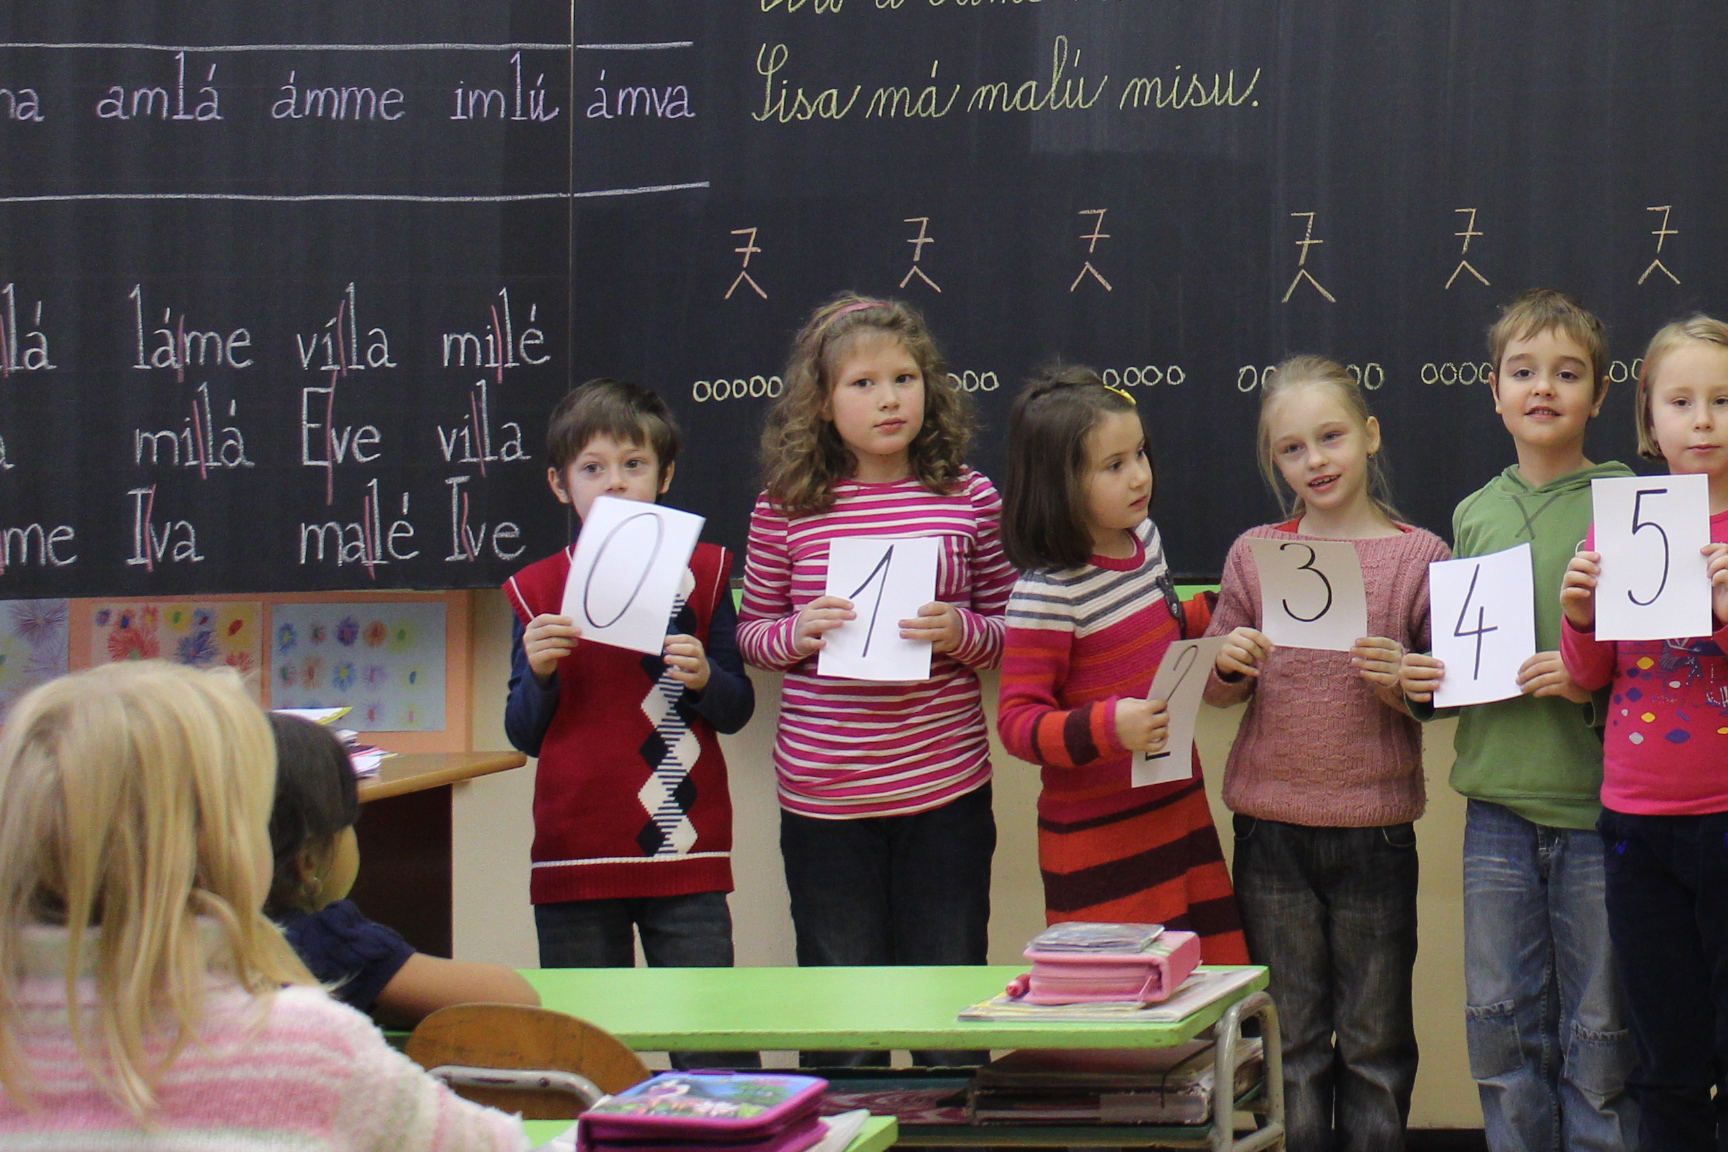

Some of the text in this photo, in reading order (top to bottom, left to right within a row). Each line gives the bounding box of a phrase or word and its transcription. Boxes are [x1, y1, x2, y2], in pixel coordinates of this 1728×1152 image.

[97, 51, 223, 121] amlá
[272, 71, 405, 120] ámme
[450, 51, 559, 121] imlú
[587, 70, 695, 118] ámva
[866, 60, 960, 118] má
[967, 35, 1108, 112] malú
[129, 284, 253, 371] láme
[443, 287, 550, 372] milé
[136, 382, 254, 470] milá
[302, 385, 381, 469] Eve
[127, 485, 204, 568] Iva
[300, 477, 419, 566] malé
[445, 476, 525, 561] Ive
[1628, 489, 1669, 605] 5
[584, 511, 665, 629] 0
[846, 545, 894, 657] 1
[1280, 543, 1332, 622] 3
[1454, 564, 1498, 680] 4
